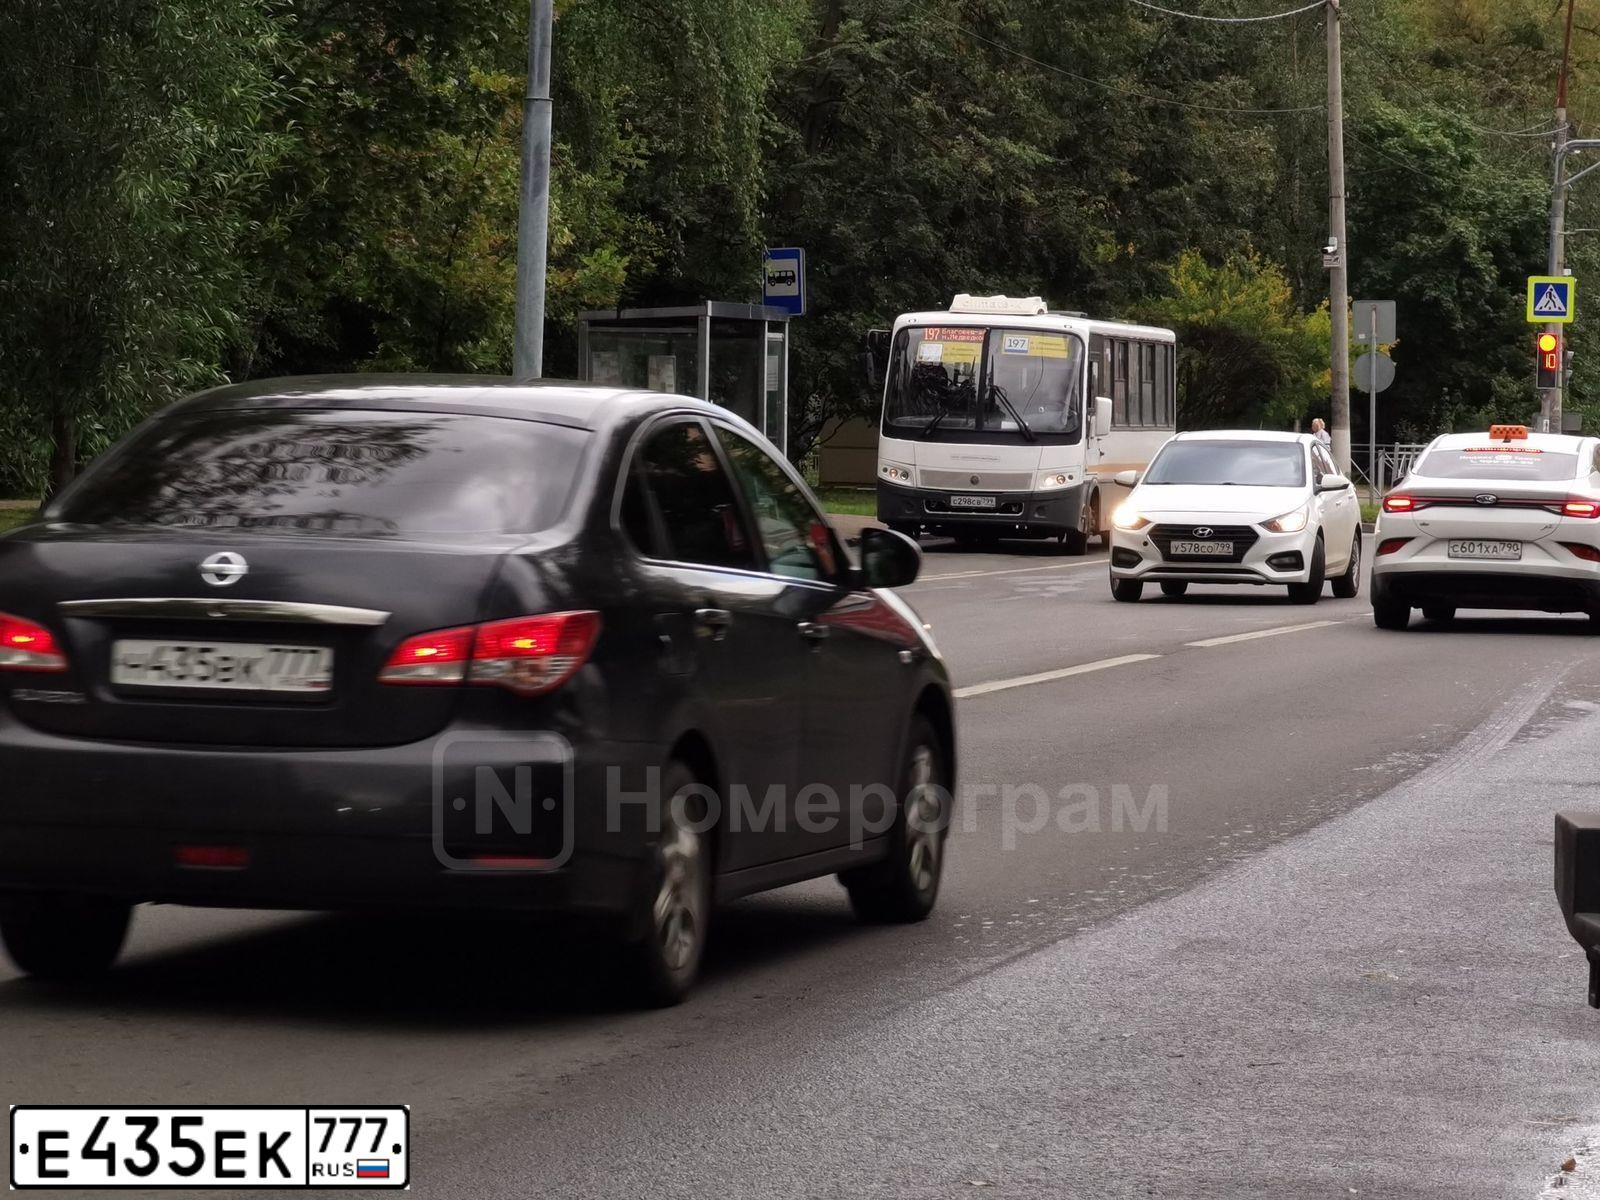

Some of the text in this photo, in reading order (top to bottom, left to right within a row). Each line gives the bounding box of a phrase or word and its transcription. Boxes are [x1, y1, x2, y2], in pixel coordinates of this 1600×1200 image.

[924, 328, 940, 340] 197
[1007, 338, 1026, 348] 197
[1545, 353, 1556, 369] 10
[1214, 543, 1231, 551] 799
